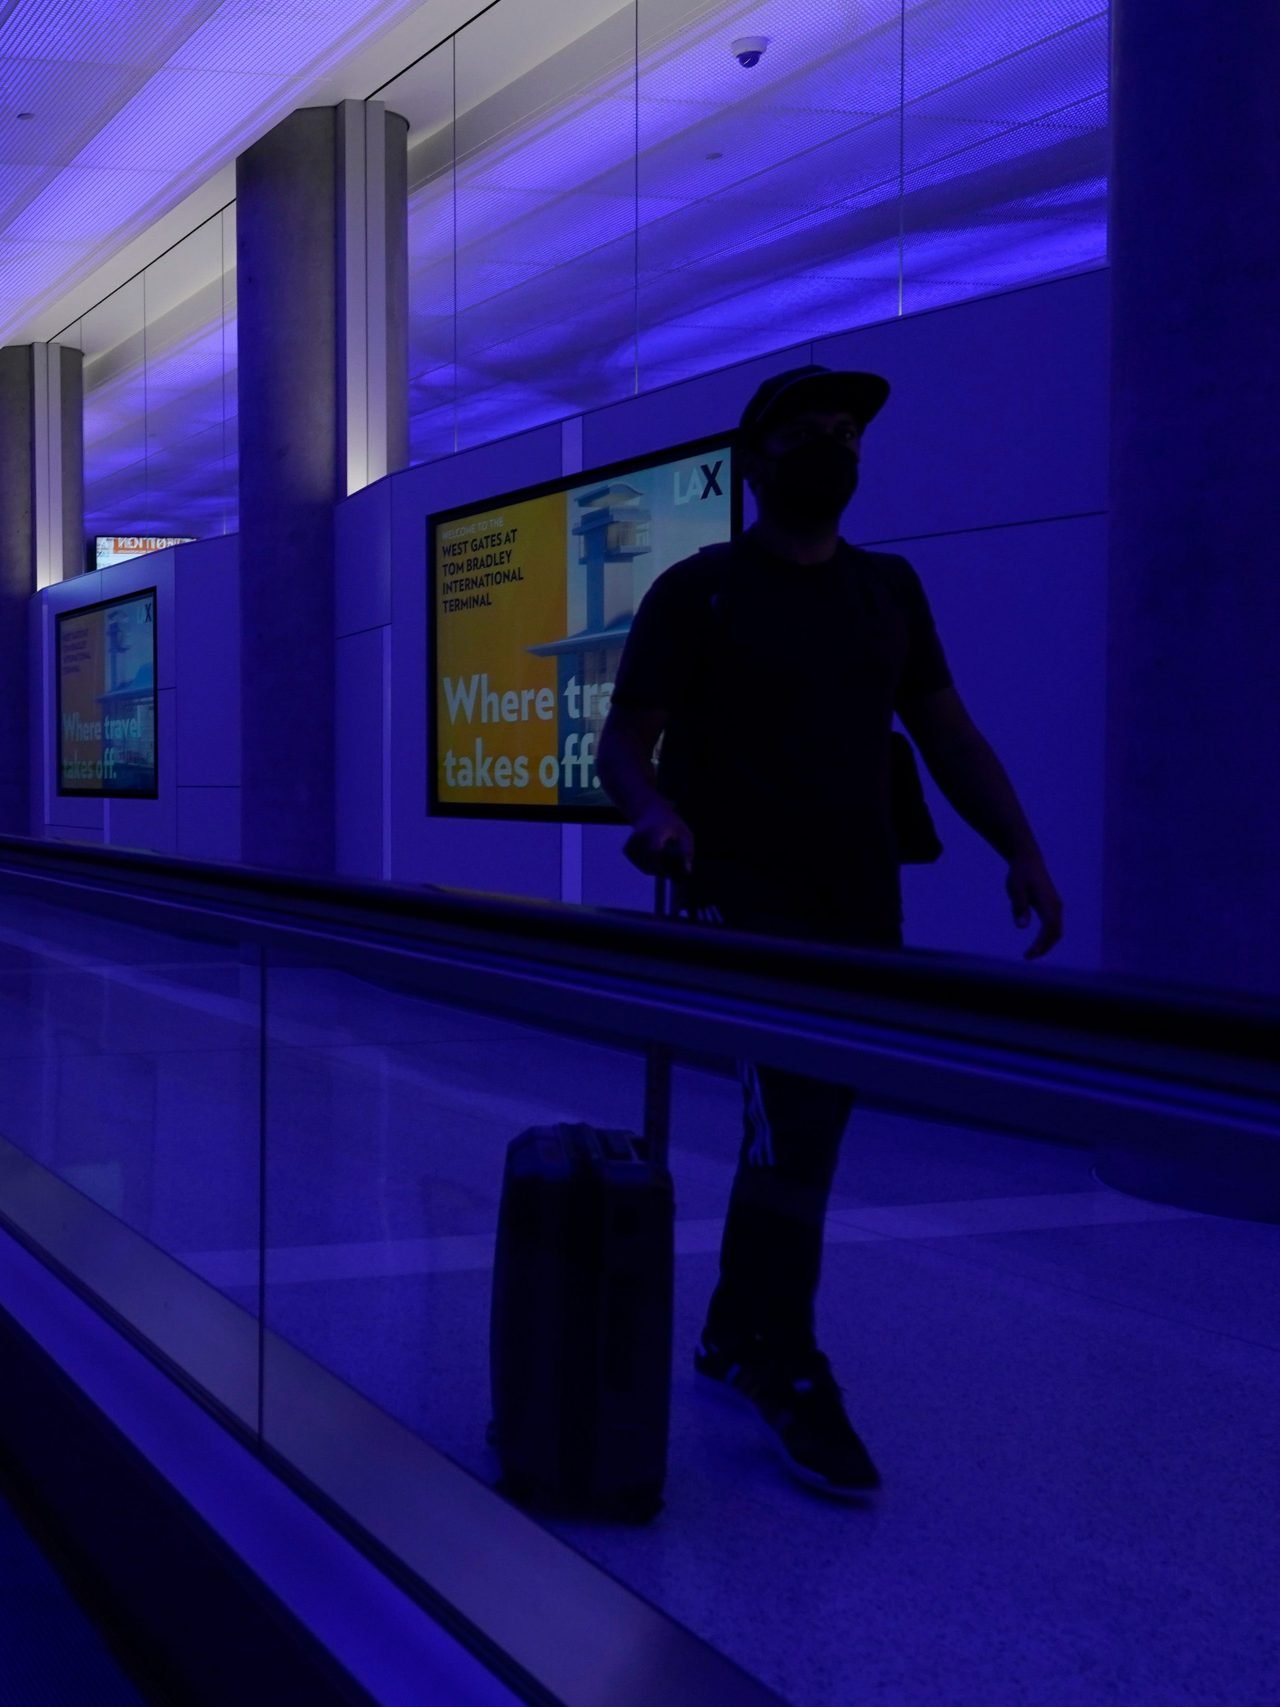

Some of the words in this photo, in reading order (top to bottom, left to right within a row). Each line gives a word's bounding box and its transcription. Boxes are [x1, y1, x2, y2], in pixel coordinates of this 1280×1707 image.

[673, 460, 724, 506] LAX
[442, 540, 469, 558] WEST
[470, 532, 502, 552] GATES
[504, 528, 518, 545] AT
[442, 562, 465, 577] TOM
[466, 549, 513, 572] BRADLEY
[442, 567, 524, 595] INTERNATIONAL
[442, 593, 493, 614] TERMINAL
[443, 673, 555, 725] Where
[63, 711, 101, 741] Where
[104, 705, 142, 740] travel
[63, 749, 94, 780] takes
[95, 747, 117, 780] off.
[444, 737, 530, 788] takes
[539, 732, 602, 789] off.
